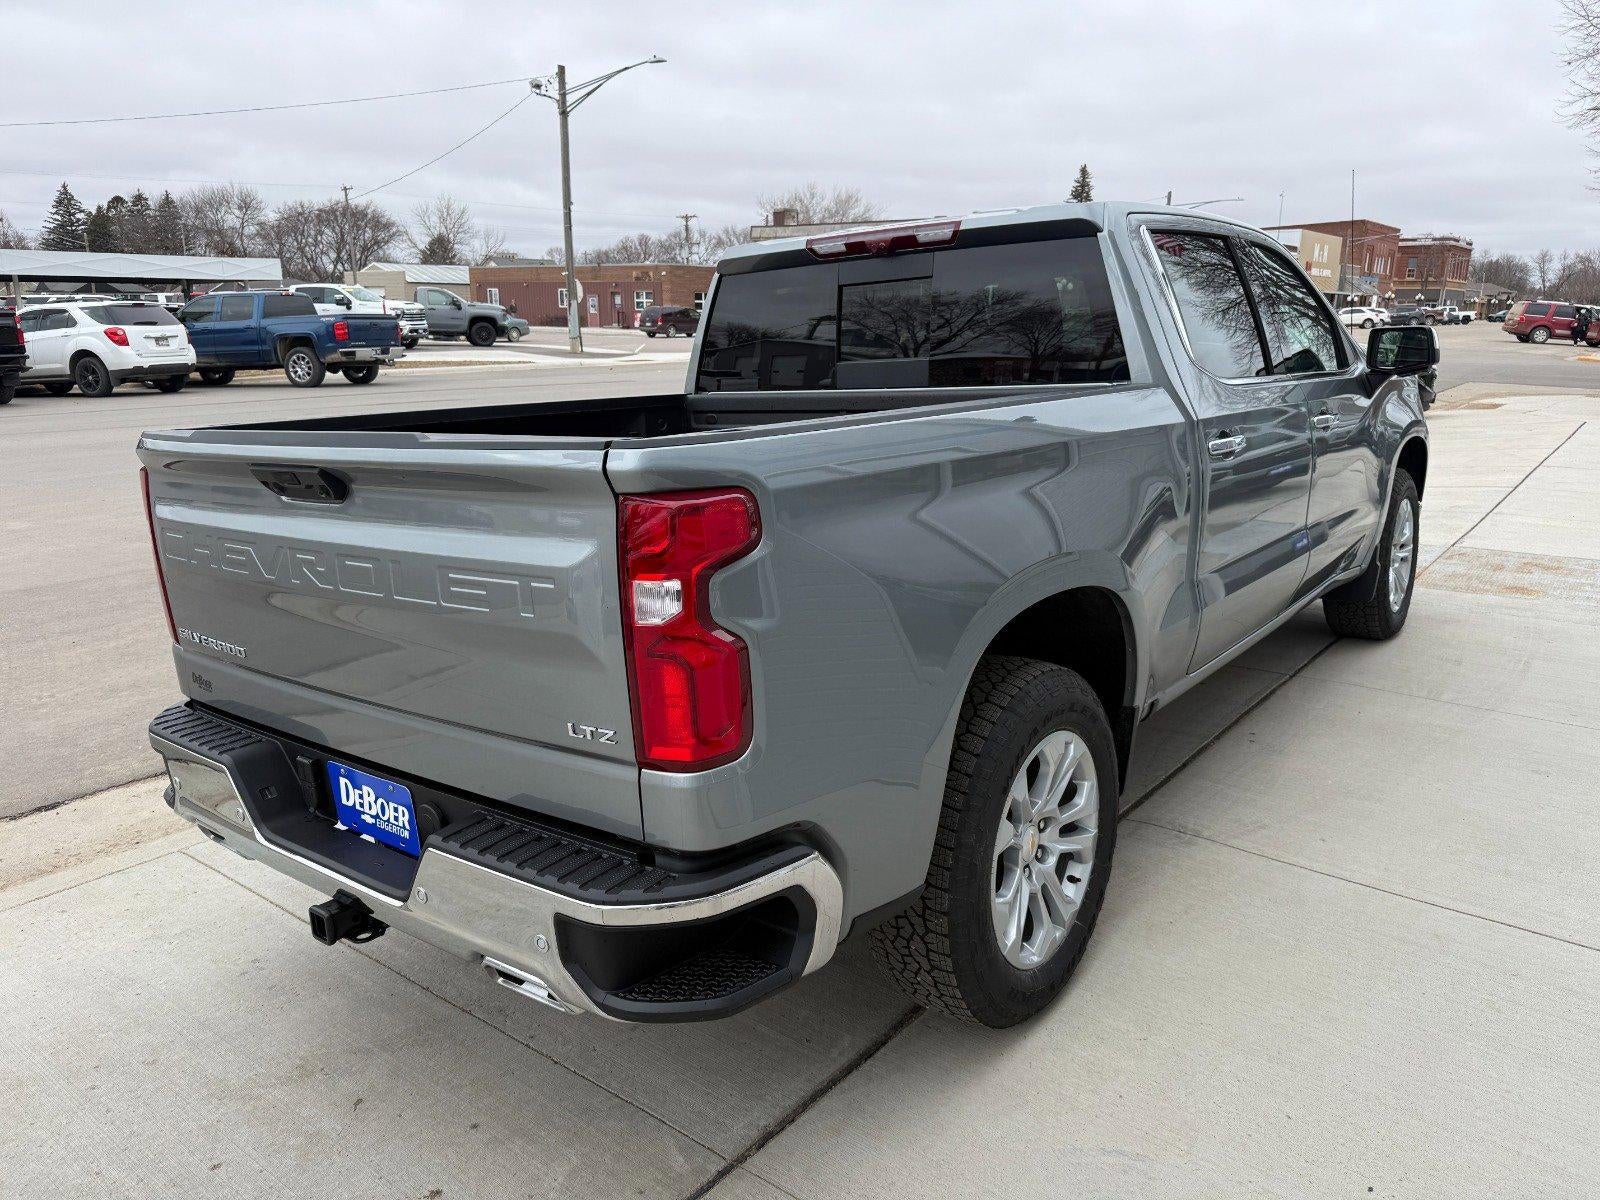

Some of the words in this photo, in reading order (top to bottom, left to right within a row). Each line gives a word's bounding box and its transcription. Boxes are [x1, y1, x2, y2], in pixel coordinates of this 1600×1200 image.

[161, 527, 555, 617] CHEVROLET
[179, 627, 247, 658] SILVERADO
[566, 721, 619, 745] LTZ
[376, 818, 410, 840] EDGERTON
